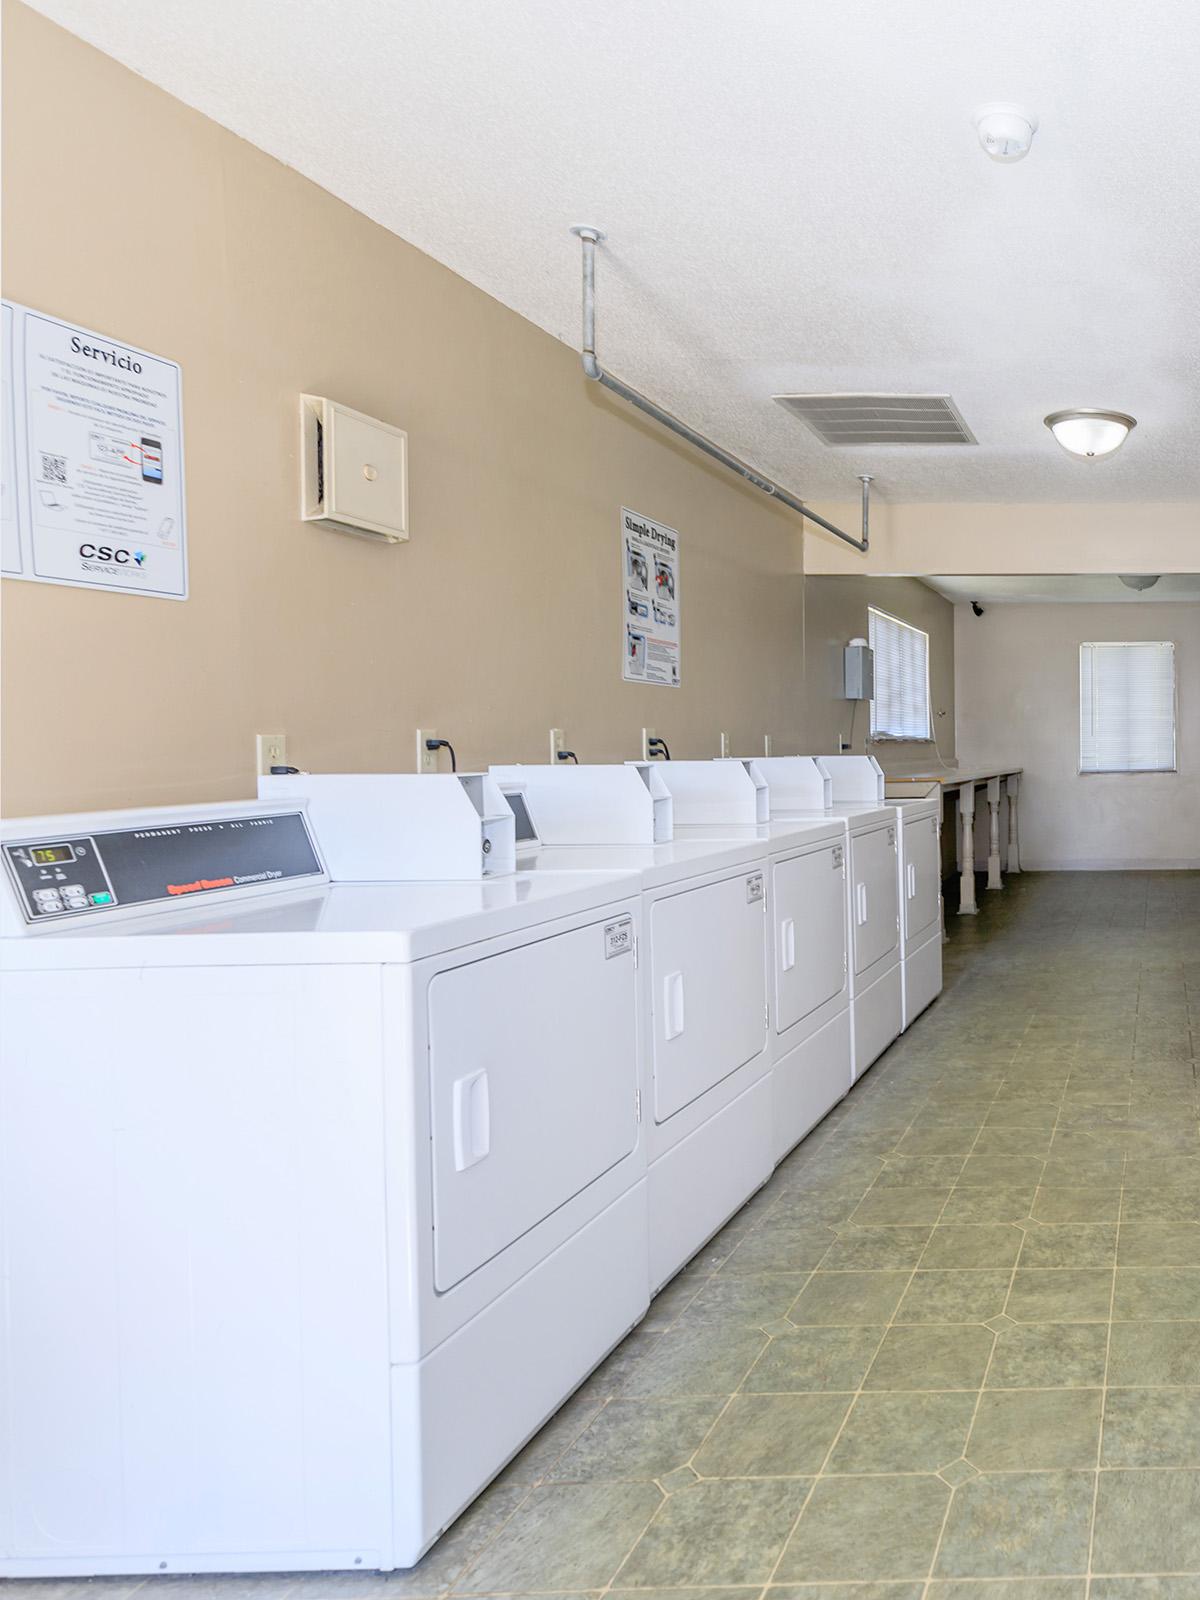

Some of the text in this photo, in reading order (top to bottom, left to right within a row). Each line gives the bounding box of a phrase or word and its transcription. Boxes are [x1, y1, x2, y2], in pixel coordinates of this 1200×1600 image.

[71, 336, 142, 375] Servicio
[625, 516, 649, 538] Simple
[651, 527, 676, 551] Drying
[79, 543, 130, 563] CSC
[233, 872, 267, 884] Commercial
[267, 870, 283, 879] Dryer
